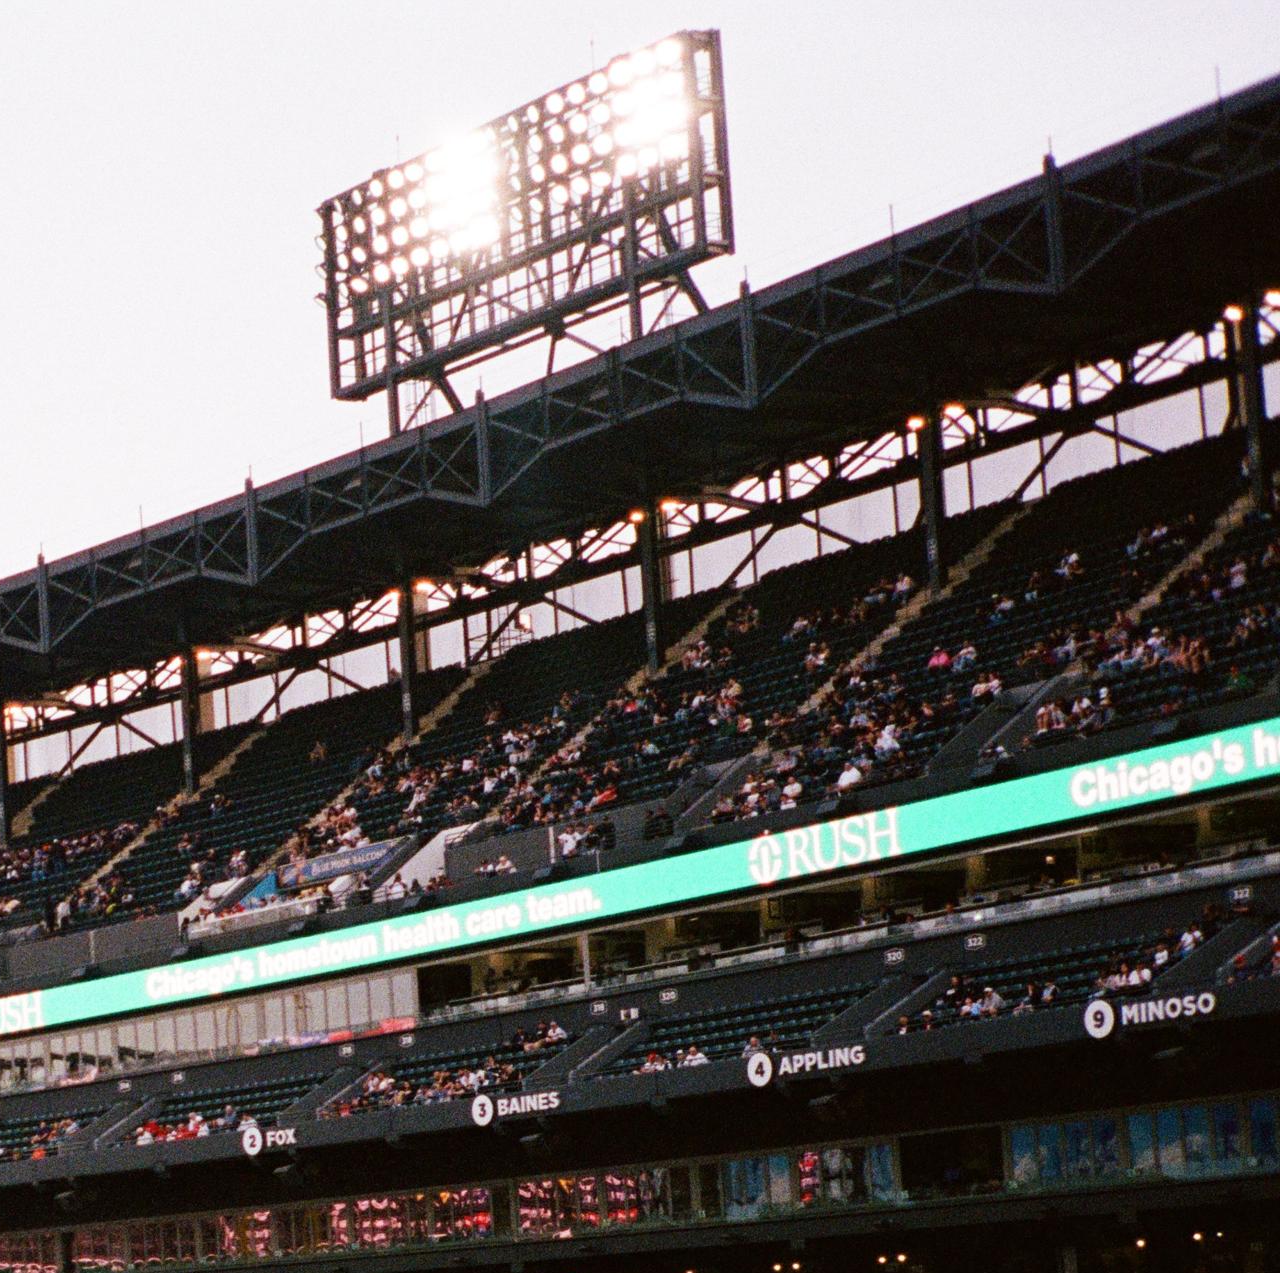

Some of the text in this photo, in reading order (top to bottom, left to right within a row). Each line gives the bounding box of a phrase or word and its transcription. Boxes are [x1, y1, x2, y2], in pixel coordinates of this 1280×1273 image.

[1069, 738, 1244, 809] Chicago's
[786, 805, 903, 881] RUSH
[144, 886, 603, 1000] Chicago's hometown health care team.
[1092, 992, 1216, 1028] 9 MINOSO
[755, 1045, 865, 1078] 4 APPLING
[477, 1091, 560, 1118] 3 BAINES
[266, 1128, 297, 1147] FOX
